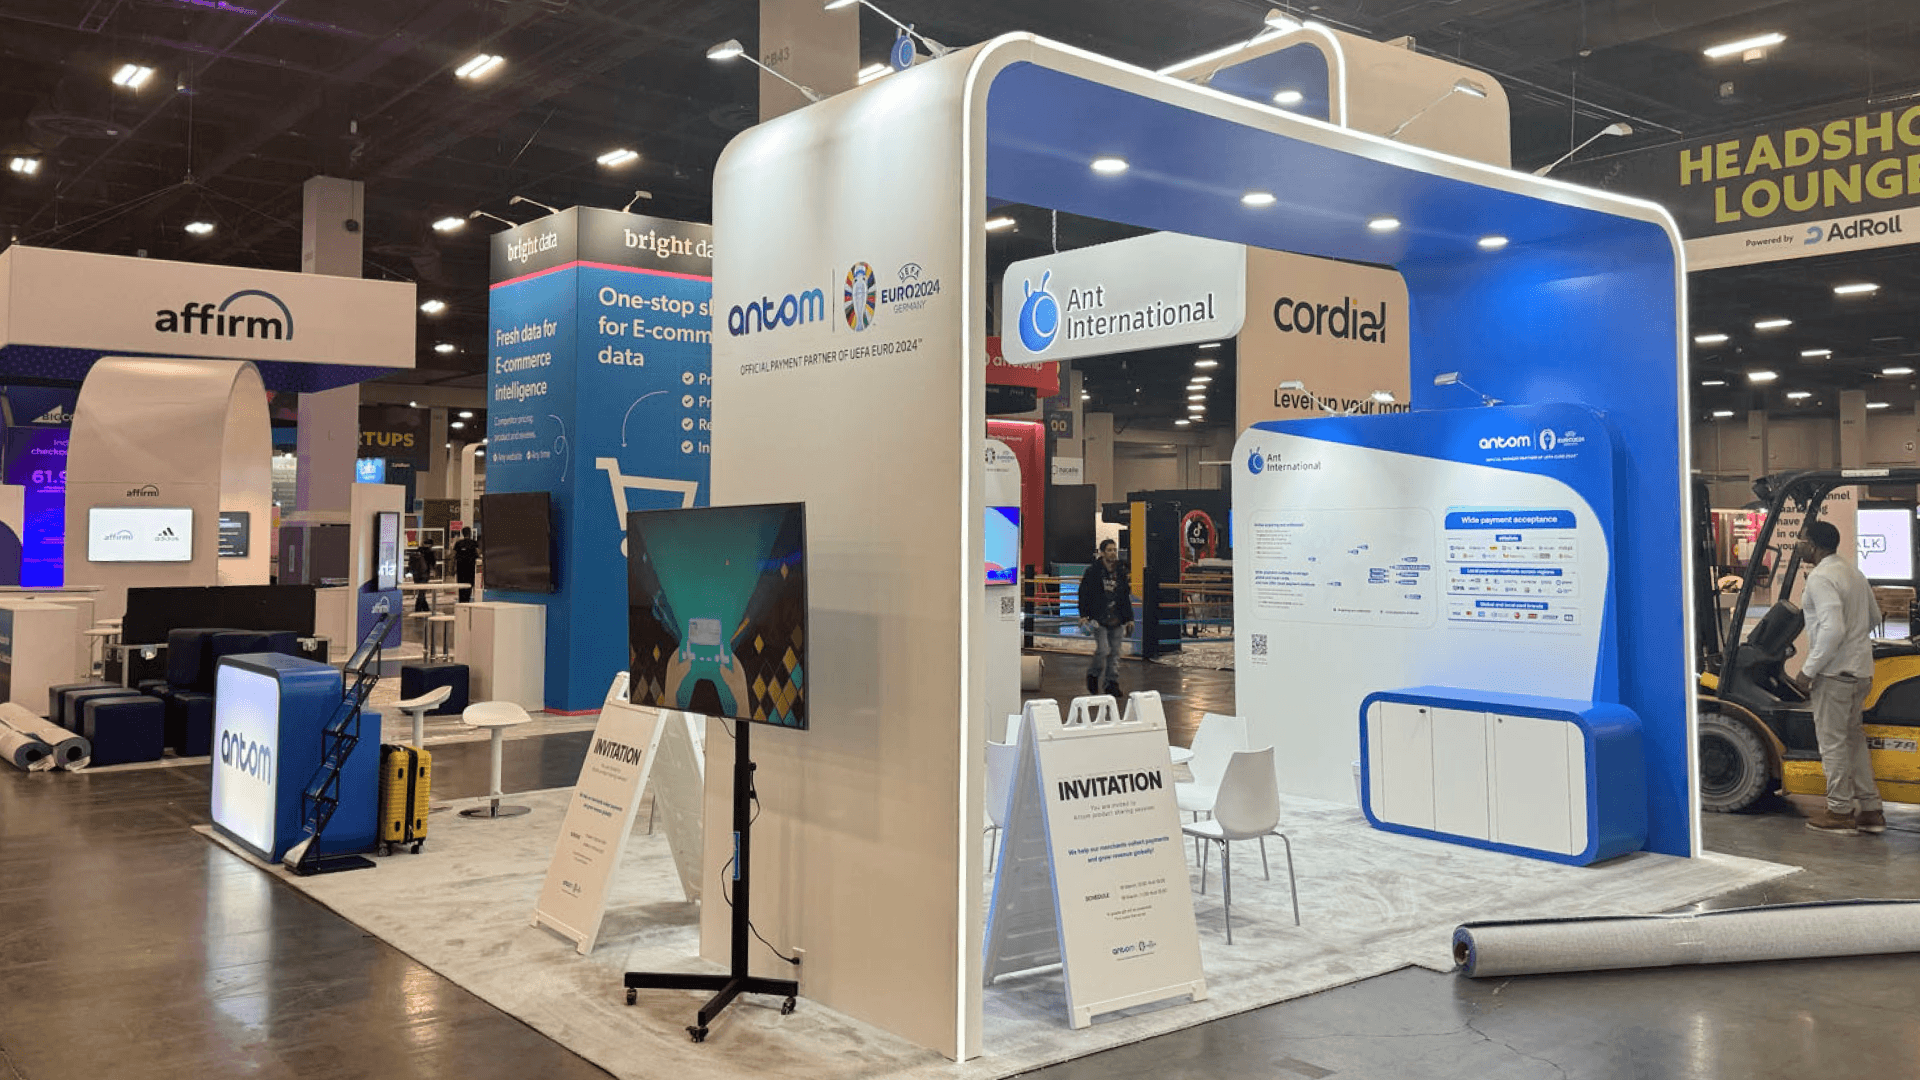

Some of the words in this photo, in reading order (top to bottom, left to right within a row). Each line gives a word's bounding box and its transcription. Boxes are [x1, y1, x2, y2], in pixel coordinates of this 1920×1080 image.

[1827, 214, 1903, 242] AdRoll
[507, 239, 537, 264] bright
[538, 231, 558, 253] data
[624, 228, 692, 258] bright
[1745, 236, 1782, 247] Powered
[1783, 235, 1794, 246] by
[898, 263, 922, 282] UEFA
[599, 287, 694, 318] One-stop
[881, 279, 940, 304] EURO2024
[1067, 286, 1103, 311] Ant
[728, 288, 824, 337] antom
[893, 300, 926, 314] GERMANY
[1067, 293, 1214, 339] International
[155, 300, 285, 340] affirm
[598, 317, 628, 337] for
[496, 329, 519, 347] Fresh
[521, 323, 542, 341] data
[543, 320, 557, 337] for
[495, 350, 552, 374] E-commerce
[598, 346, 644, 367] data
[740, 362, 770, 376] OFFICIAL
[771, 356, 803, 371] PAYMENT
[804, 351, 837, 366] PARTNER
[838, 349, 849, 361] OF
[849, 346, 870, 360] UEFA
[871, 342, 894, 356] EURO
[495, 380, 548, 402] intelligence
[1274, 389, 1313, 411] Level
[1341, 397, 1375, 415] your
[1479, 435, 1531, 449] antom
[1267, 453, 1281, 462] Ant
[1267, 460, 1321, 472] International
[126, 486, 158, 497] affirm
[1461, 516, 1479, 524] Wide
[1480, 517, 1512, 525] payment
[1513, 516, 1558, 524] acceptance
[104, 530, 132, 541] affirm
[1777, 528, 1786, 537] in
[222, 729, 271, 785] antom
[593, 738, 642, 766] INVITATION
[1058, 770, 1163, 801] INVITATION
[1092, 811, 1113, 819] product
[1114, 808, 1133, 816] sharing
[1077, 847, 1089, 855] help
[1100, 842, 1127, 851] merchants
[1128, 839, 1145, 847] collect
[1145, 836, 1169, 845] payments
[1085, 892, 1110, 902] SCHEDULE
[1112, 945, 1135, 955] antom
